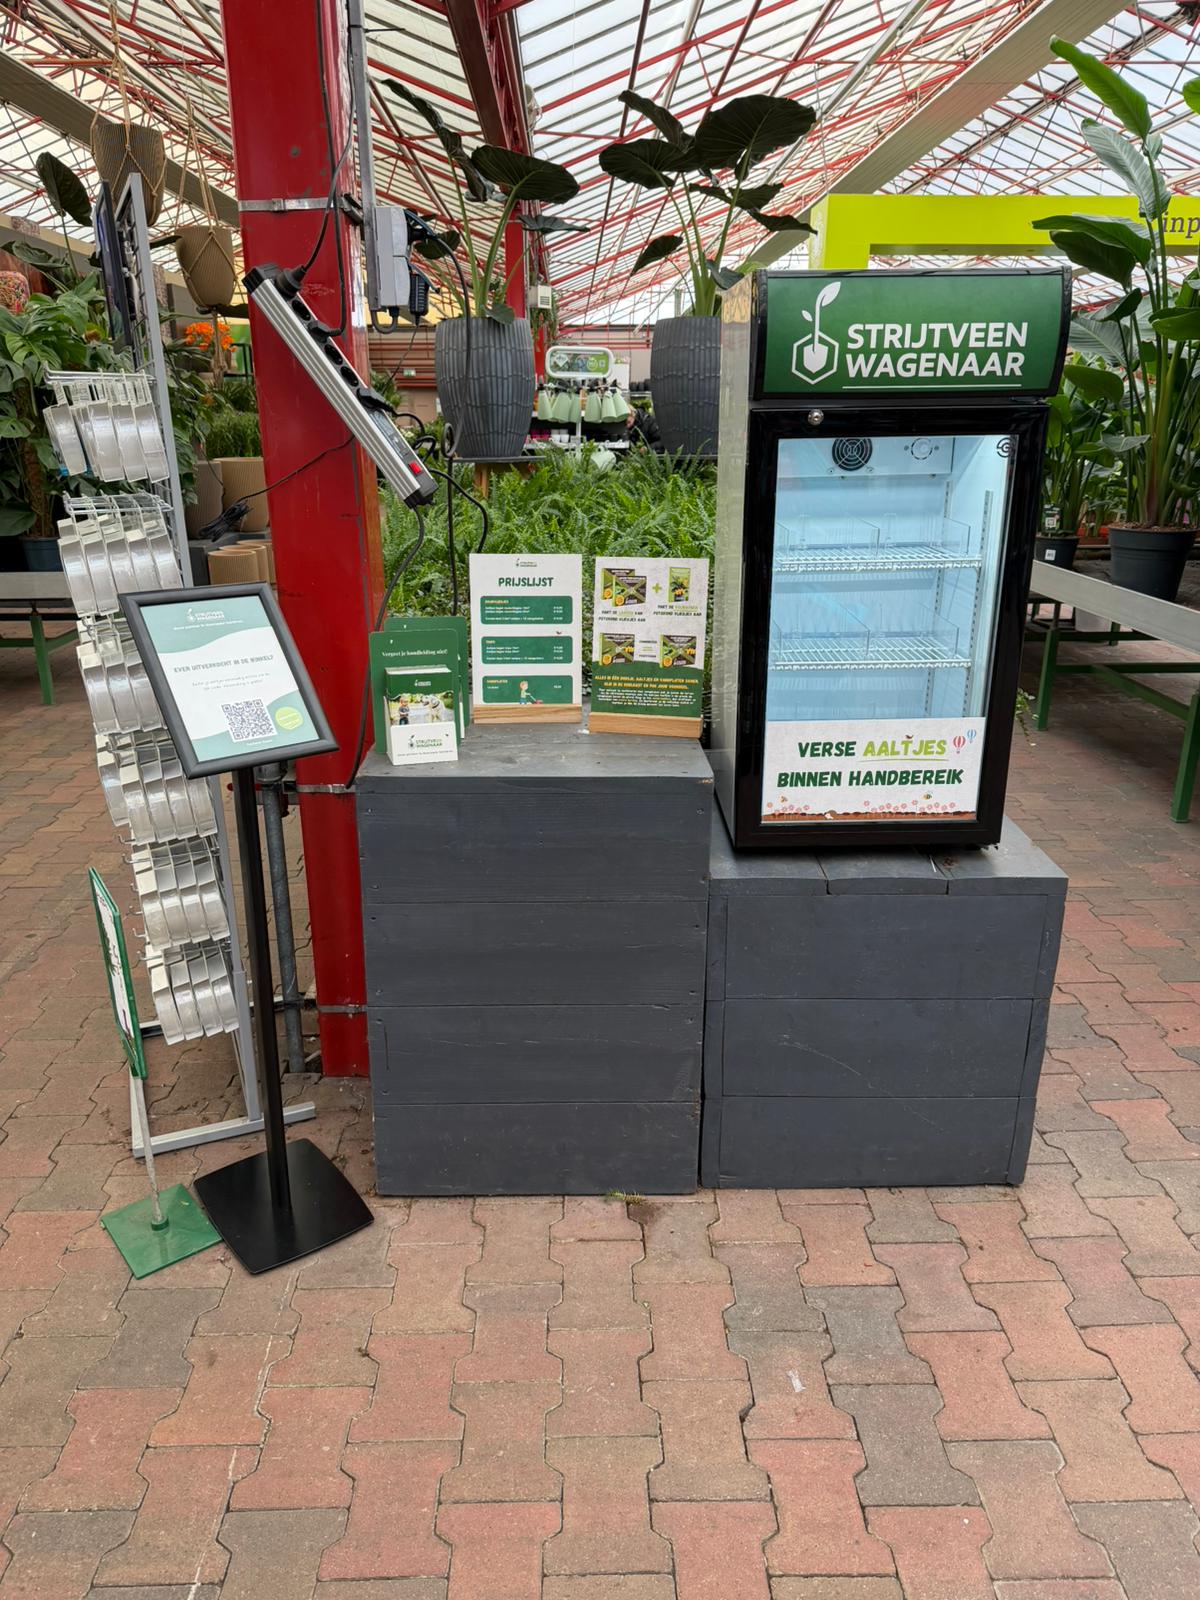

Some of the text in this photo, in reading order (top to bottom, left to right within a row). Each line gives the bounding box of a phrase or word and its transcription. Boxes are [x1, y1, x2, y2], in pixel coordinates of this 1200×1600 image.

[847, 322, 1028, 349] STRIJTVEEN
[846, 352, 1025, 378] WAGENAAR
[498, 577, 554, 587] PRIJSLIJST
[192, 660, 232, 671] UITVERKOCHT
[798, 740, 947, 758] VERSE AALTJES
[777, 769, 964, 788] BINNEN HANDBEREIK
